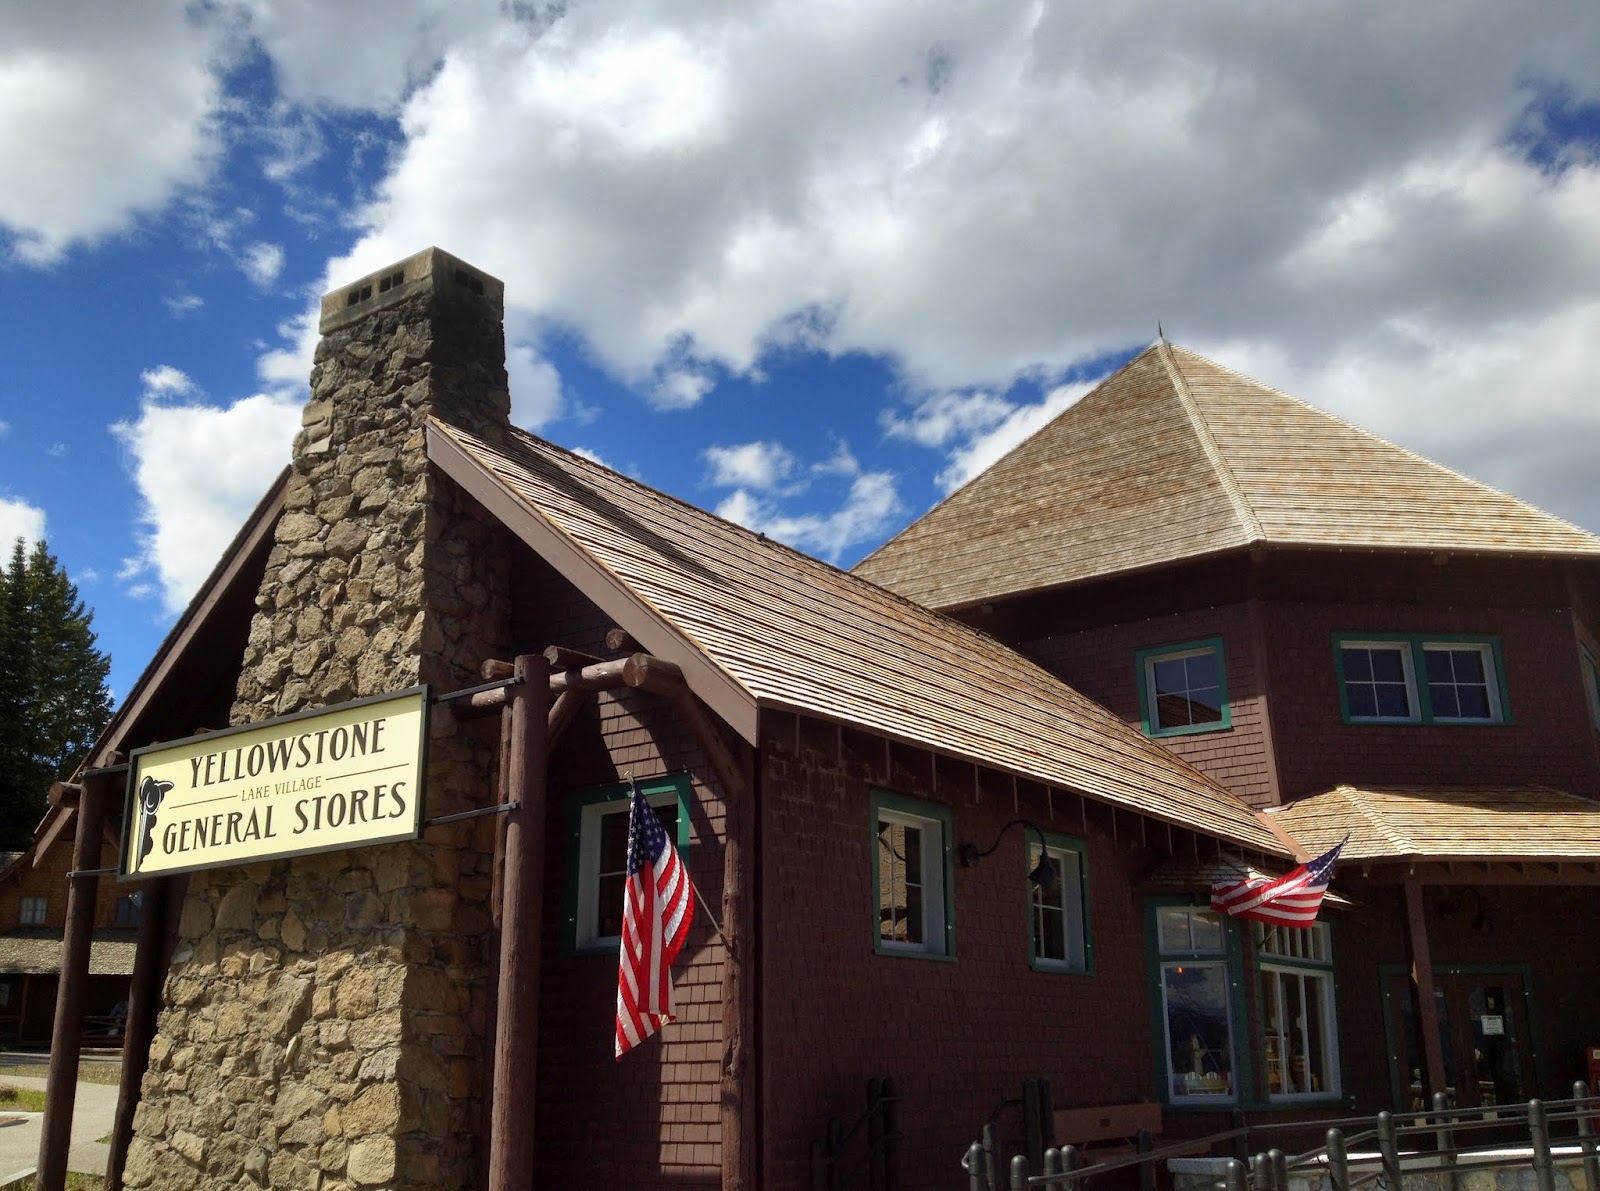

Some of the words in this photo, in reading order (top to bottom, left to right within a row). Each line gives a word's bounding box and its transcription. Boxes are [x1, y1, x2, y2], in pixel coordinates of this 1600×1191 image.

[190, 718, 386, 788] YELLOWSTONE
[162, 804, 277, 855] GENERAL
[292, 781, 406, 835] STORES
[241, 785, 270, 802] LAKE
[274, 775, 322, 795] VILLAGE
